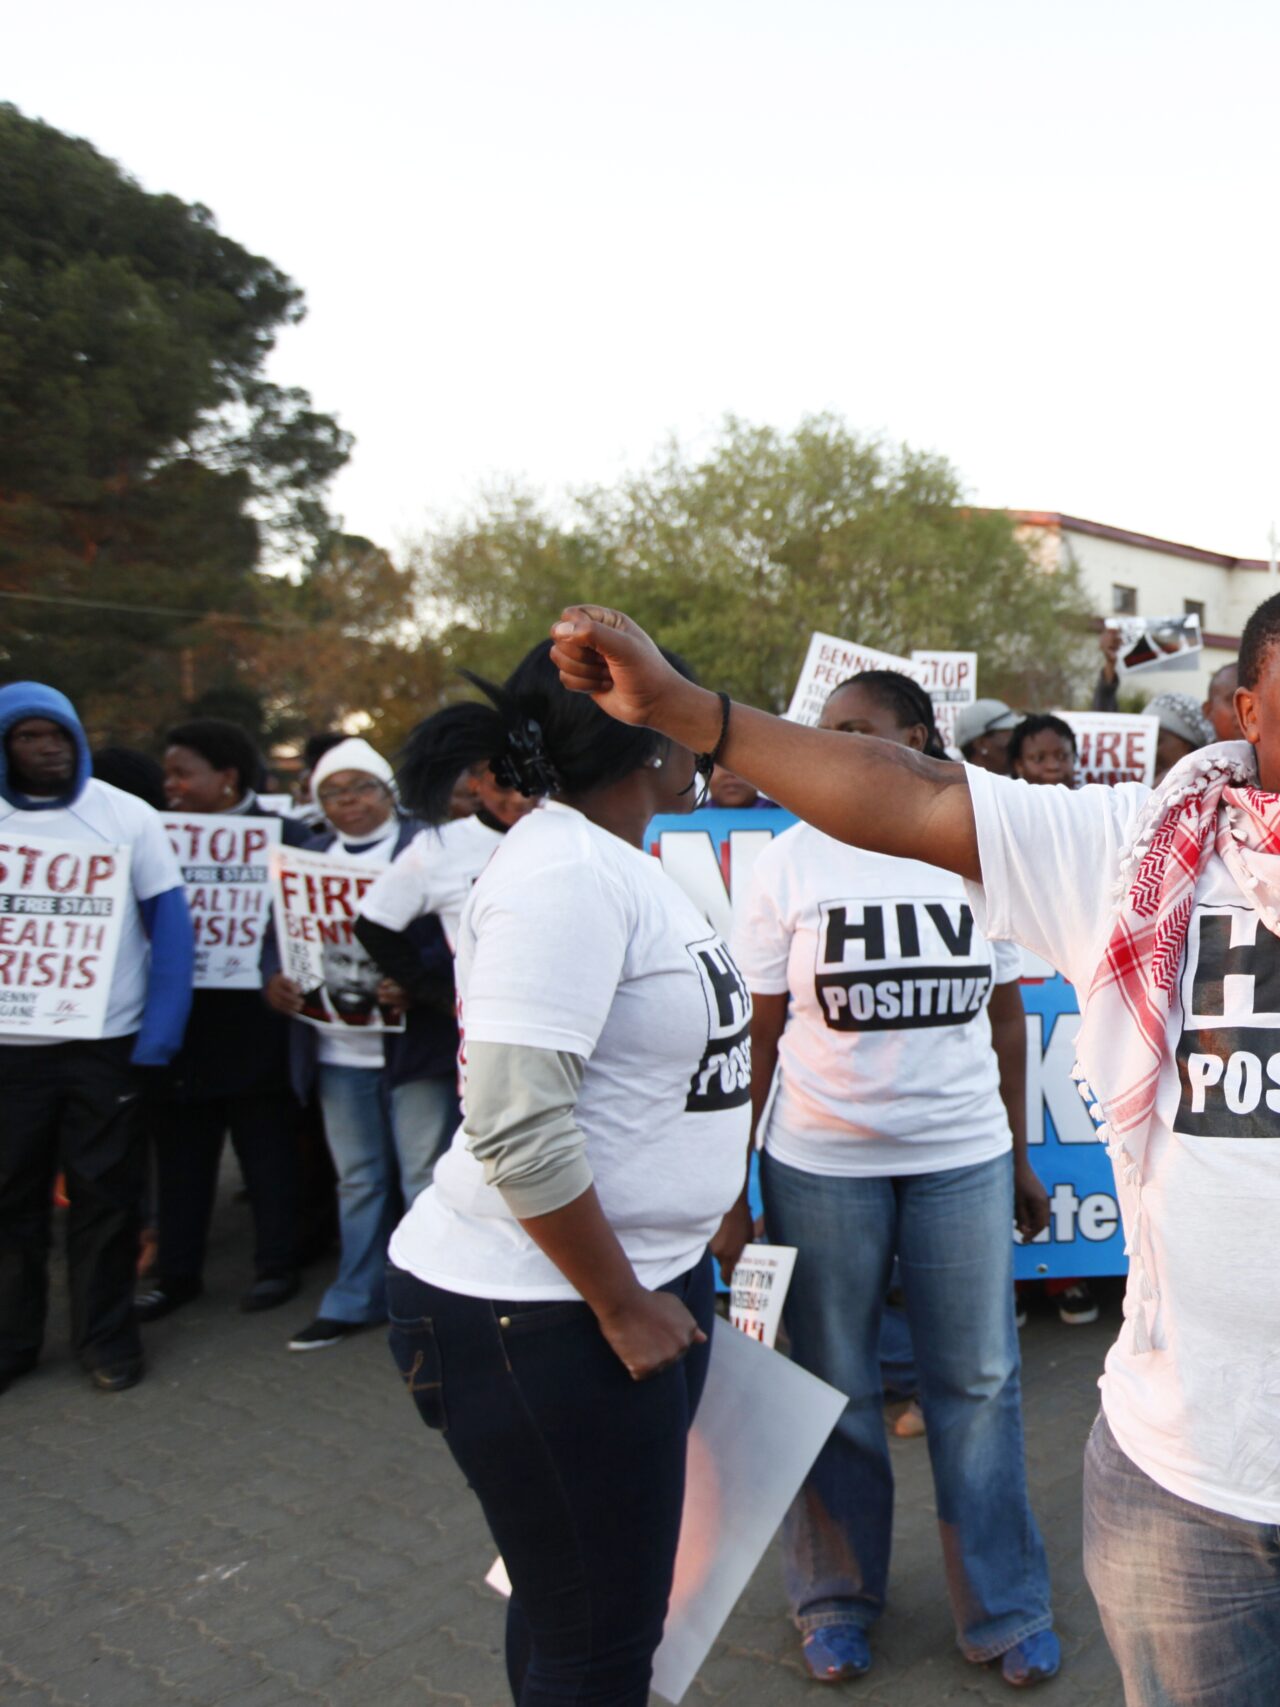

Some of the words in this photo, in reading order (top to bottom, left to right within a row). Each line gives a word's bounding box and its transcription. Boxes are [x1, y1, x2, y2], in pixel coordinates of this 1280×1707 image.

[14, 898, 56, 914] FREE
[60, 901, 112, 916] STATE
[824, 903, 975, 965] HIV
[822, 976, 991, 1021] POSITIVE
